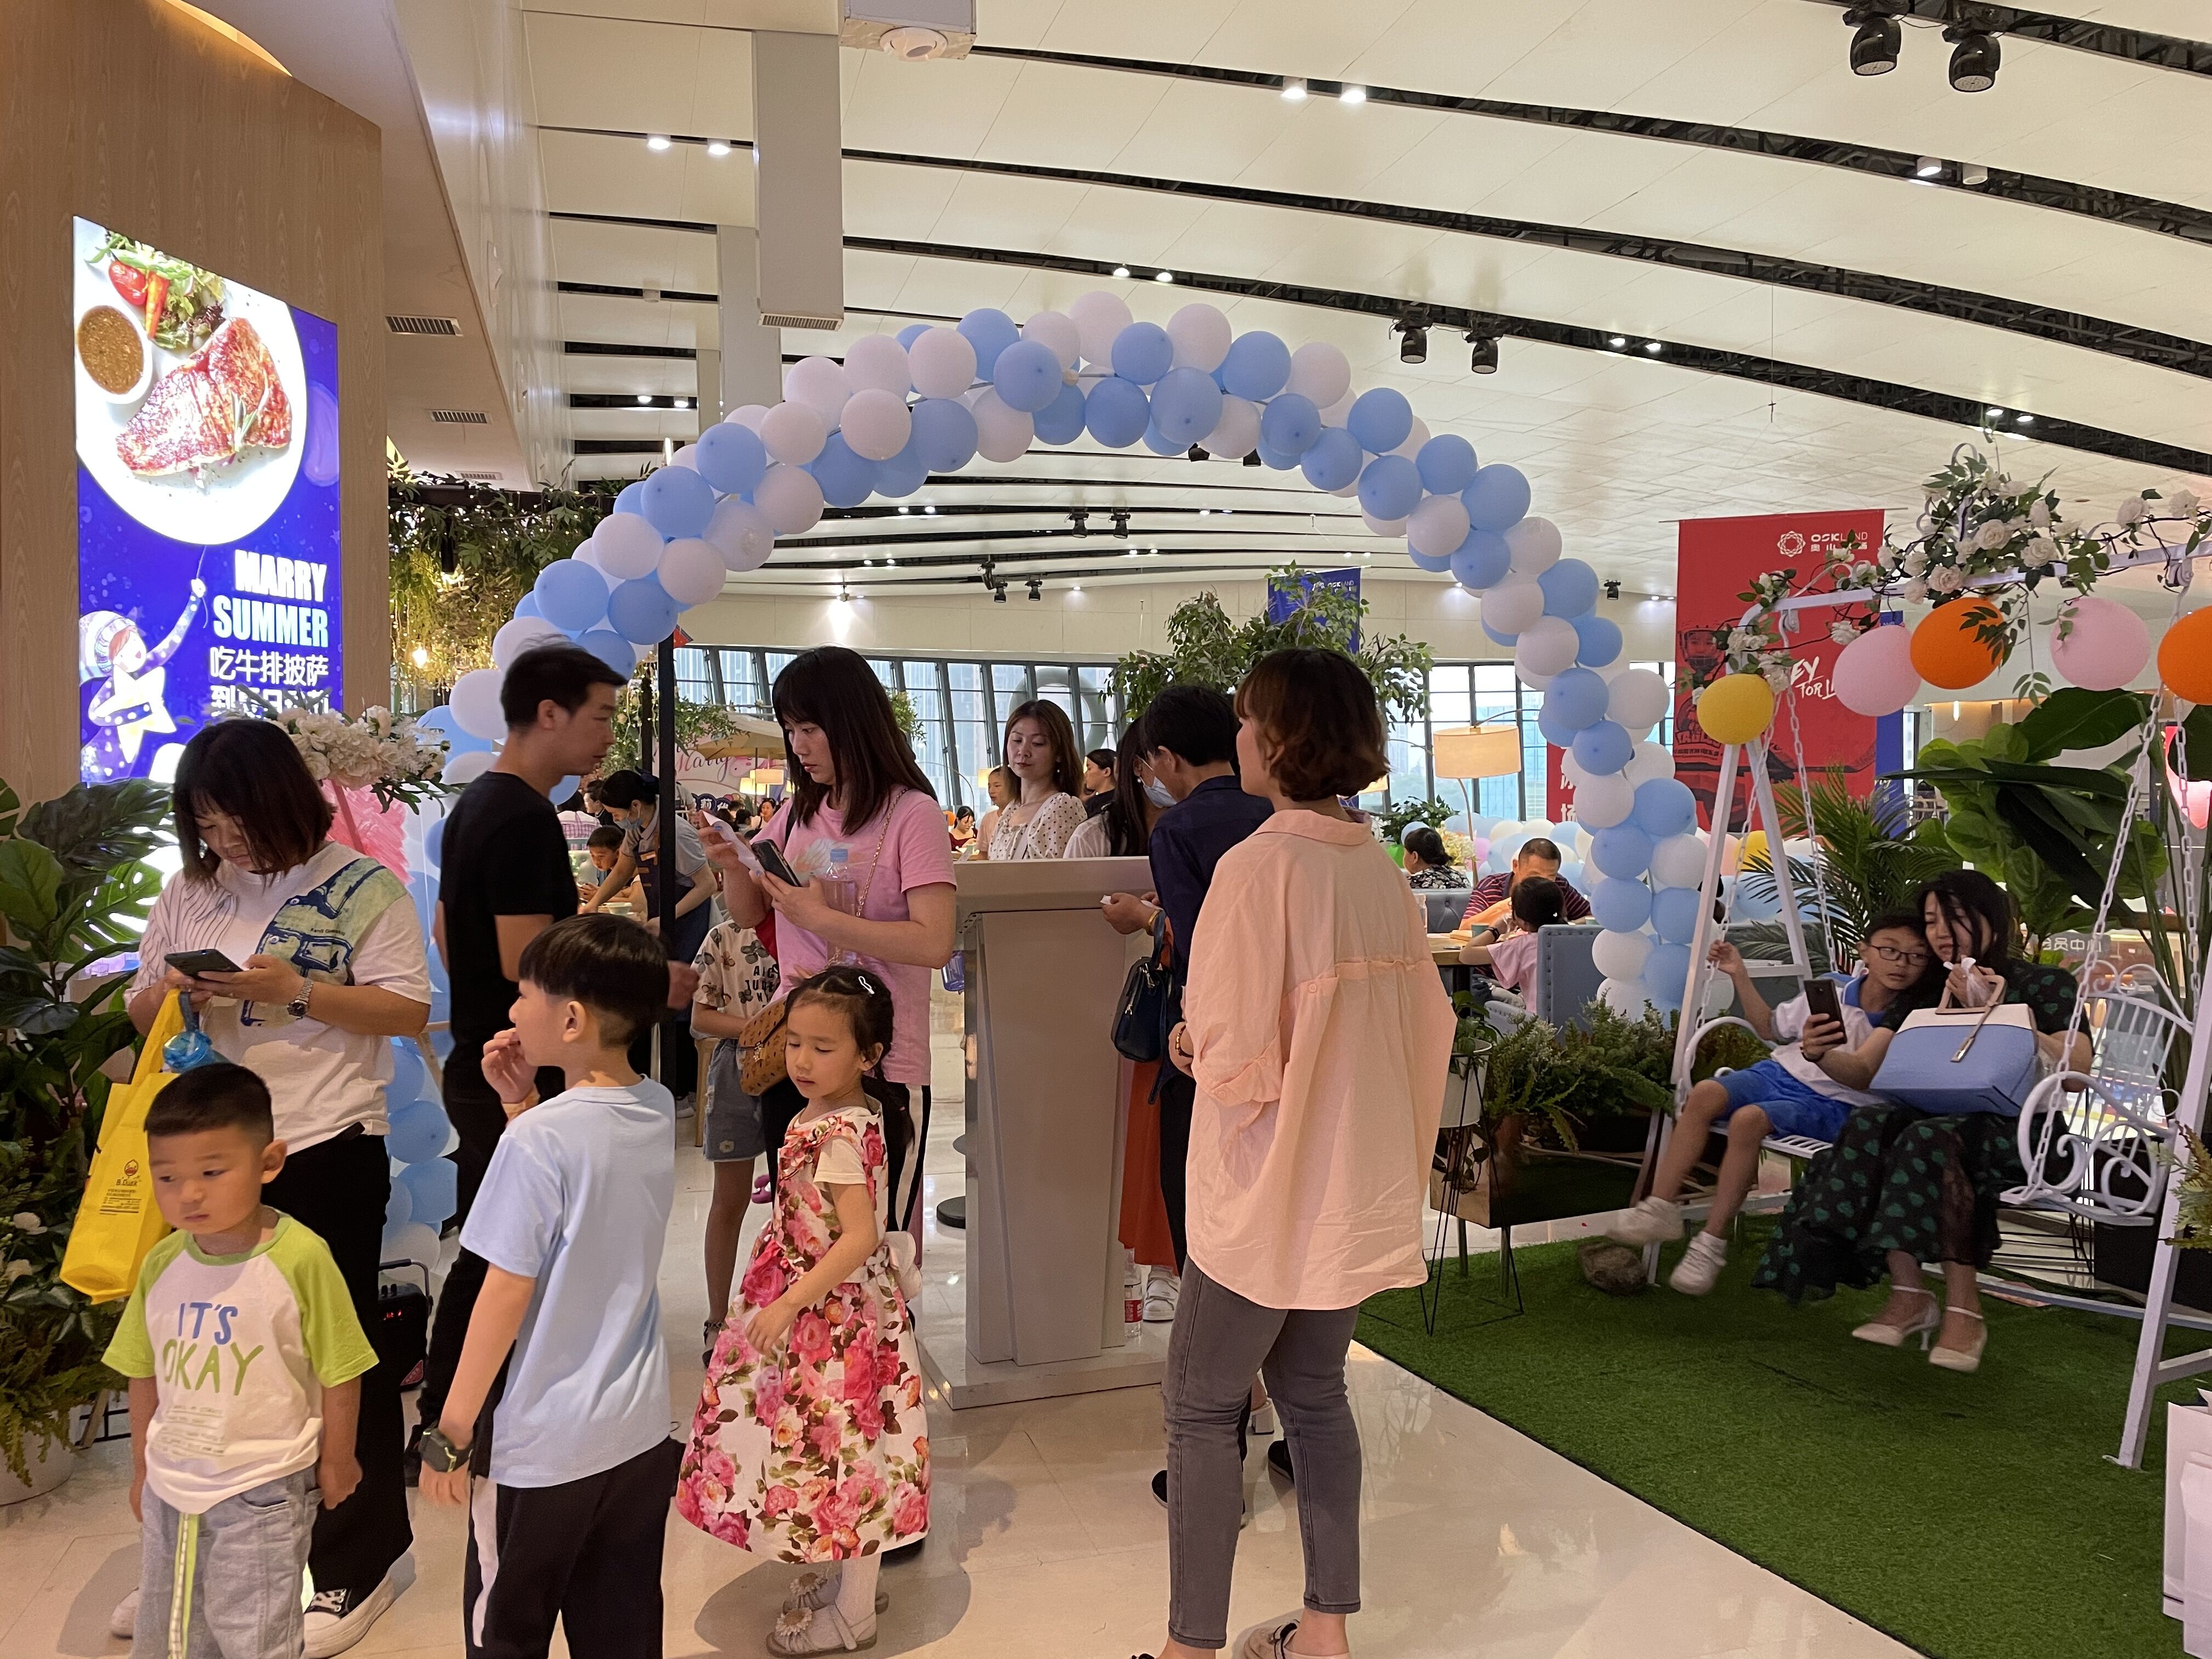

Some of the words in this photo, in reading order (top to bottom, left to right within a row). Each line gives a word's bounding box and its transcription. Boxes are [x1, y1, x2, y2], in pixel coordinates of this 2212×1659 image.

[1811, 532, 1867, 542] OSKLND
[235, 549, 328, 602] MARRY
[213, 595, 329, 648] SUMMER
[210, 645, 329, 686] 吃牛排披萨
[178, 1302, 238, 1345] IT'S
[163, 1339, 264, 1396] OKAY
